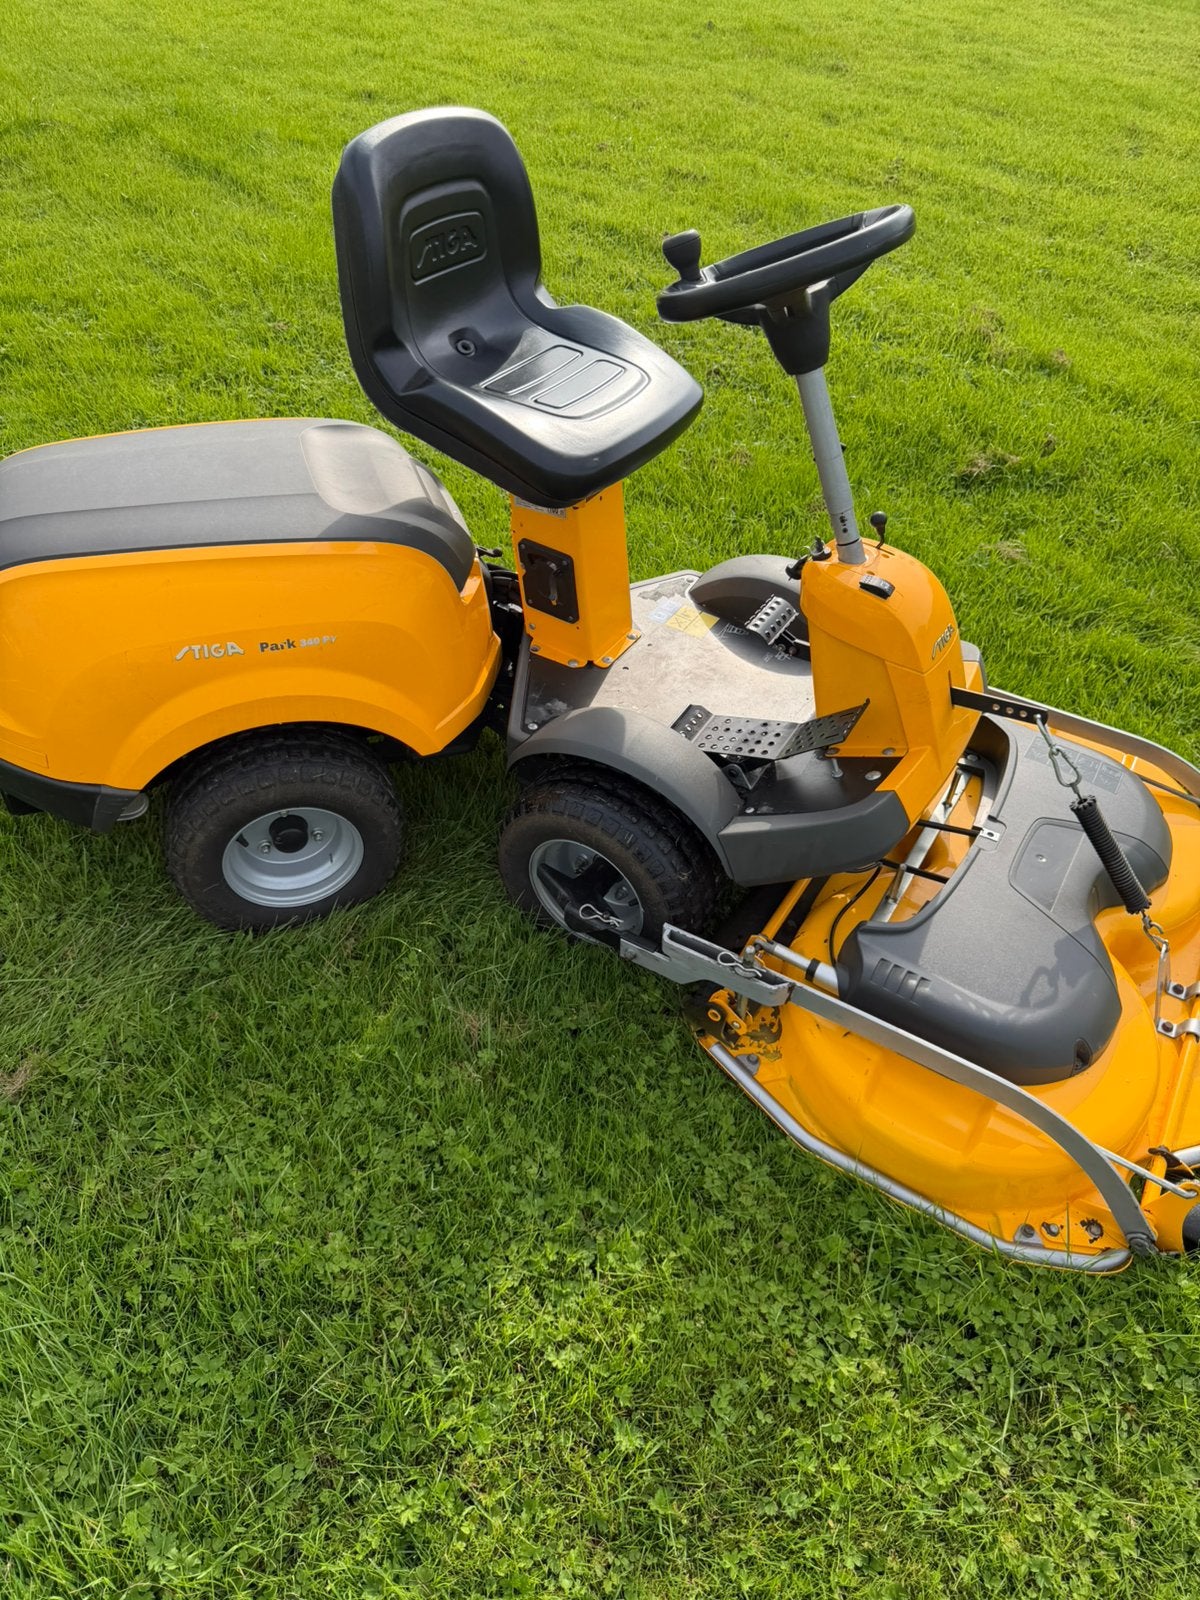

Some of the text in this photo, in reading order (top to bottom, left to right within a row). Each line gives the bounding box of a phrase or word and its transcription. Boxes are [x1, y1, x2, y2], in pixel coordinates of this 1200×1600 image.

[416, 225, 478, 269] STIGA
[175, 641, 244, 661] STIGA
[259, 638, 296, 653] Park
